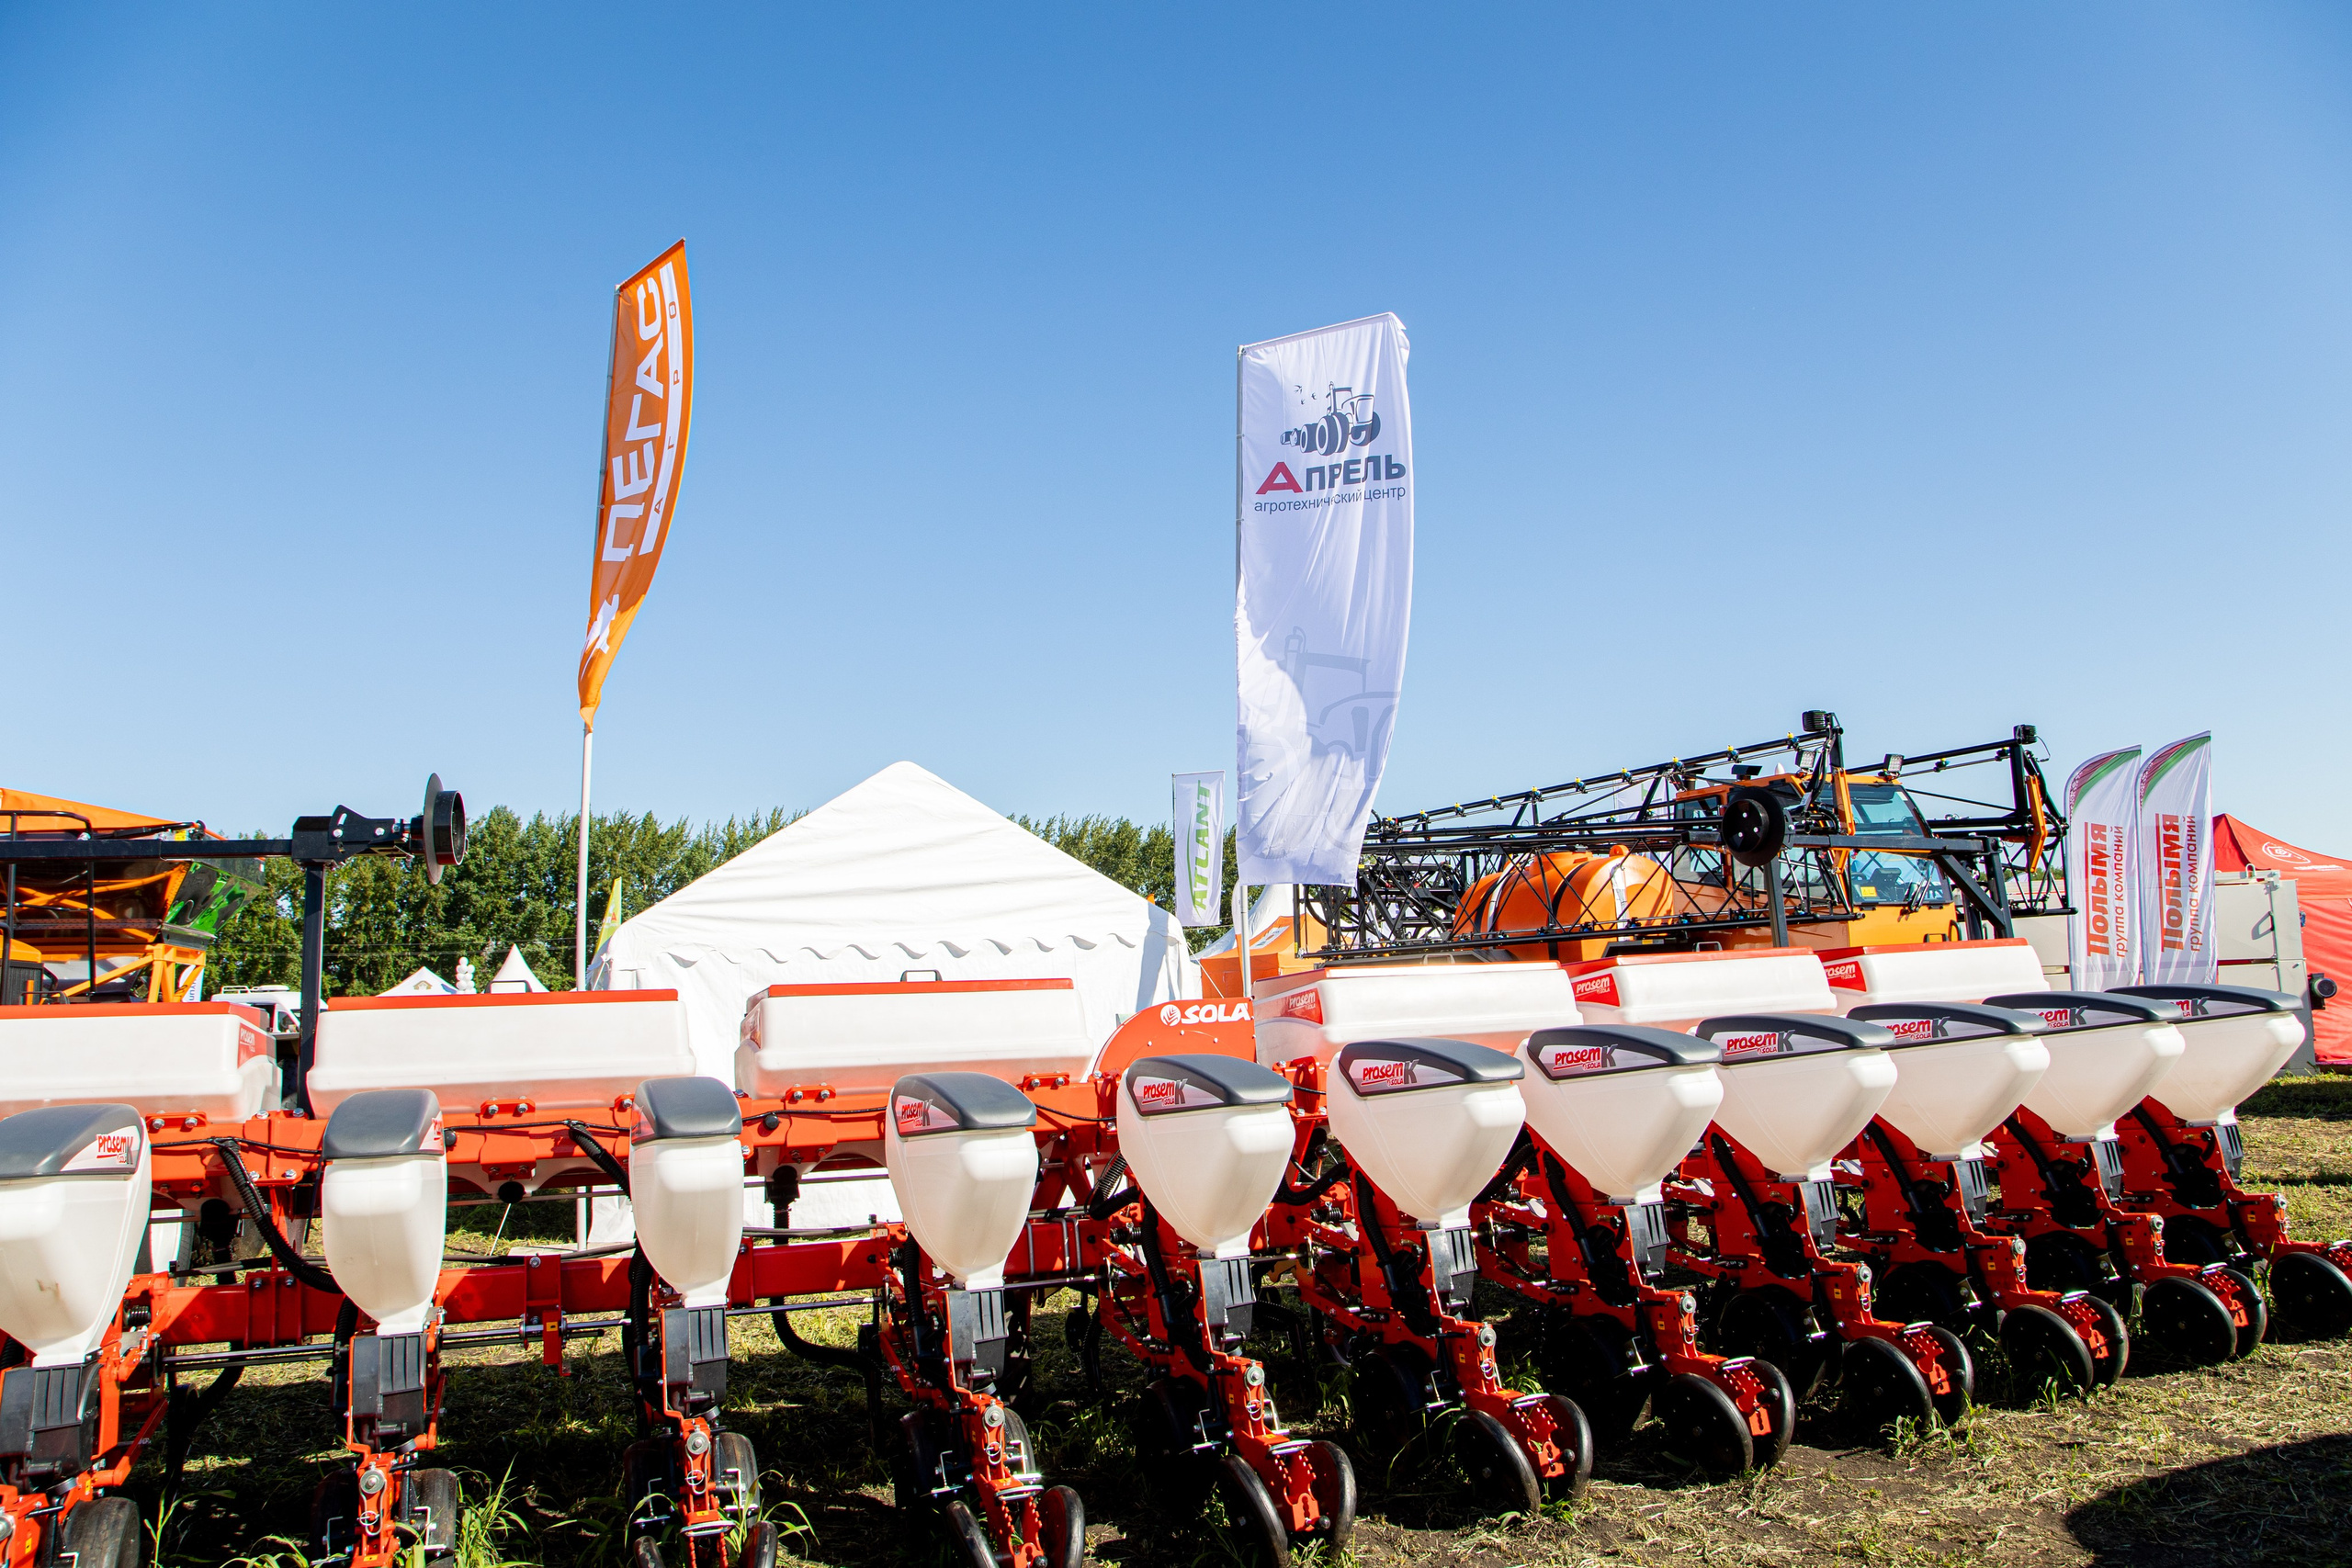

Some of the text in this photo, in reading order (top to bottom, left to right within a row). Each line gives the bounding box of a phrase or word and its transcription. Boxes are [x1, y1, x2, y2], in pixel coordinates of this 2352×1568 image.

[602, 277, 663, 561] ПЕГАС
[1363, 486, 1406, 502] центр
[1193, 780, 1210, 910] ATLANT
[2110, 826, 2128, 957] группа компаний
[2183, 816, 2203, 952] группа компаний
[1181, 1002, 1250, 1024] SOLA
